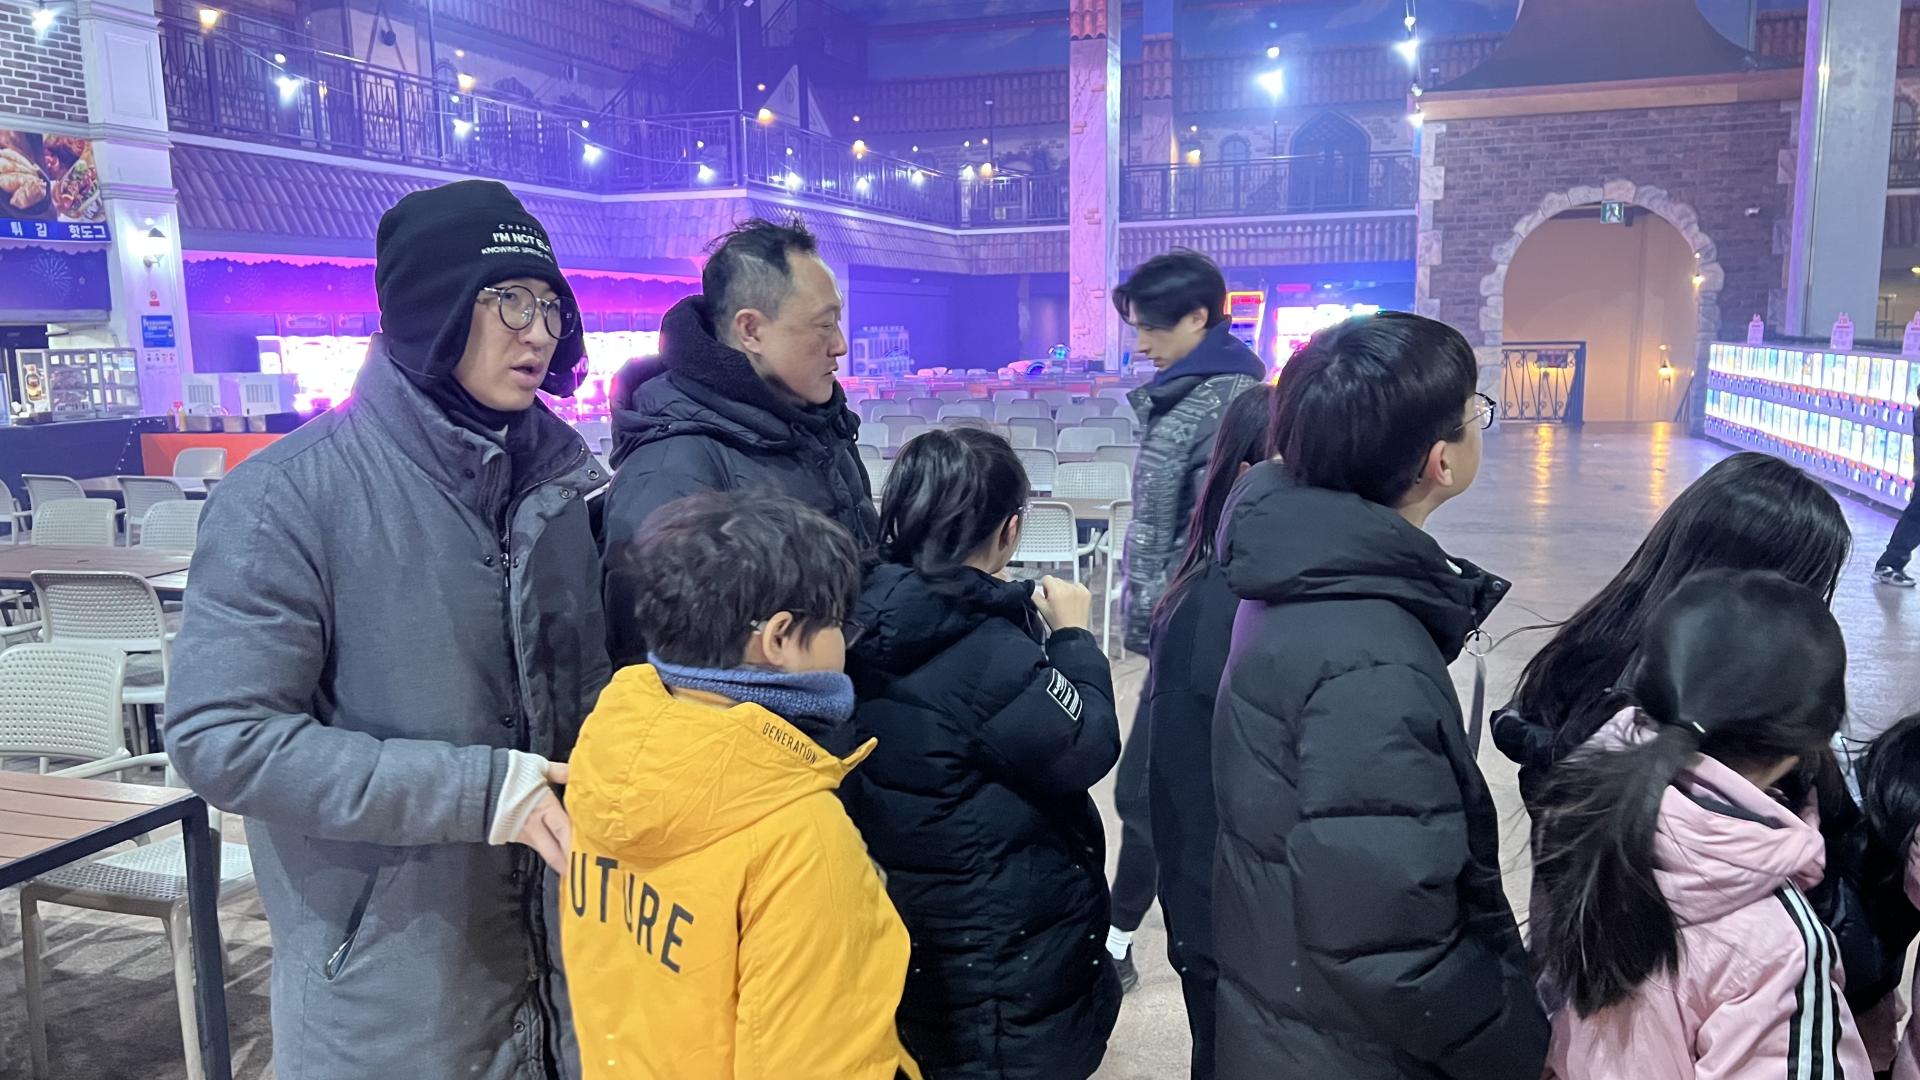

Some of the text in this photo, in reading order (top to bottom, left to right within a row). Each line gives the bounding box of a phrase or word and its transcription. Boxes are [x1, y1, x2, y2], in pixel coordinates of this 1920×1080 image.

[68, 224, 107, 239] 핫도그
[492, 232, 512, 243] I'M
[512, 233, 535, 245] NOT
[481, 246, 520, 255] KNOWING
[762, 722, 818, 765] GENERATION
[570, 851, 694, 974] UTURE
